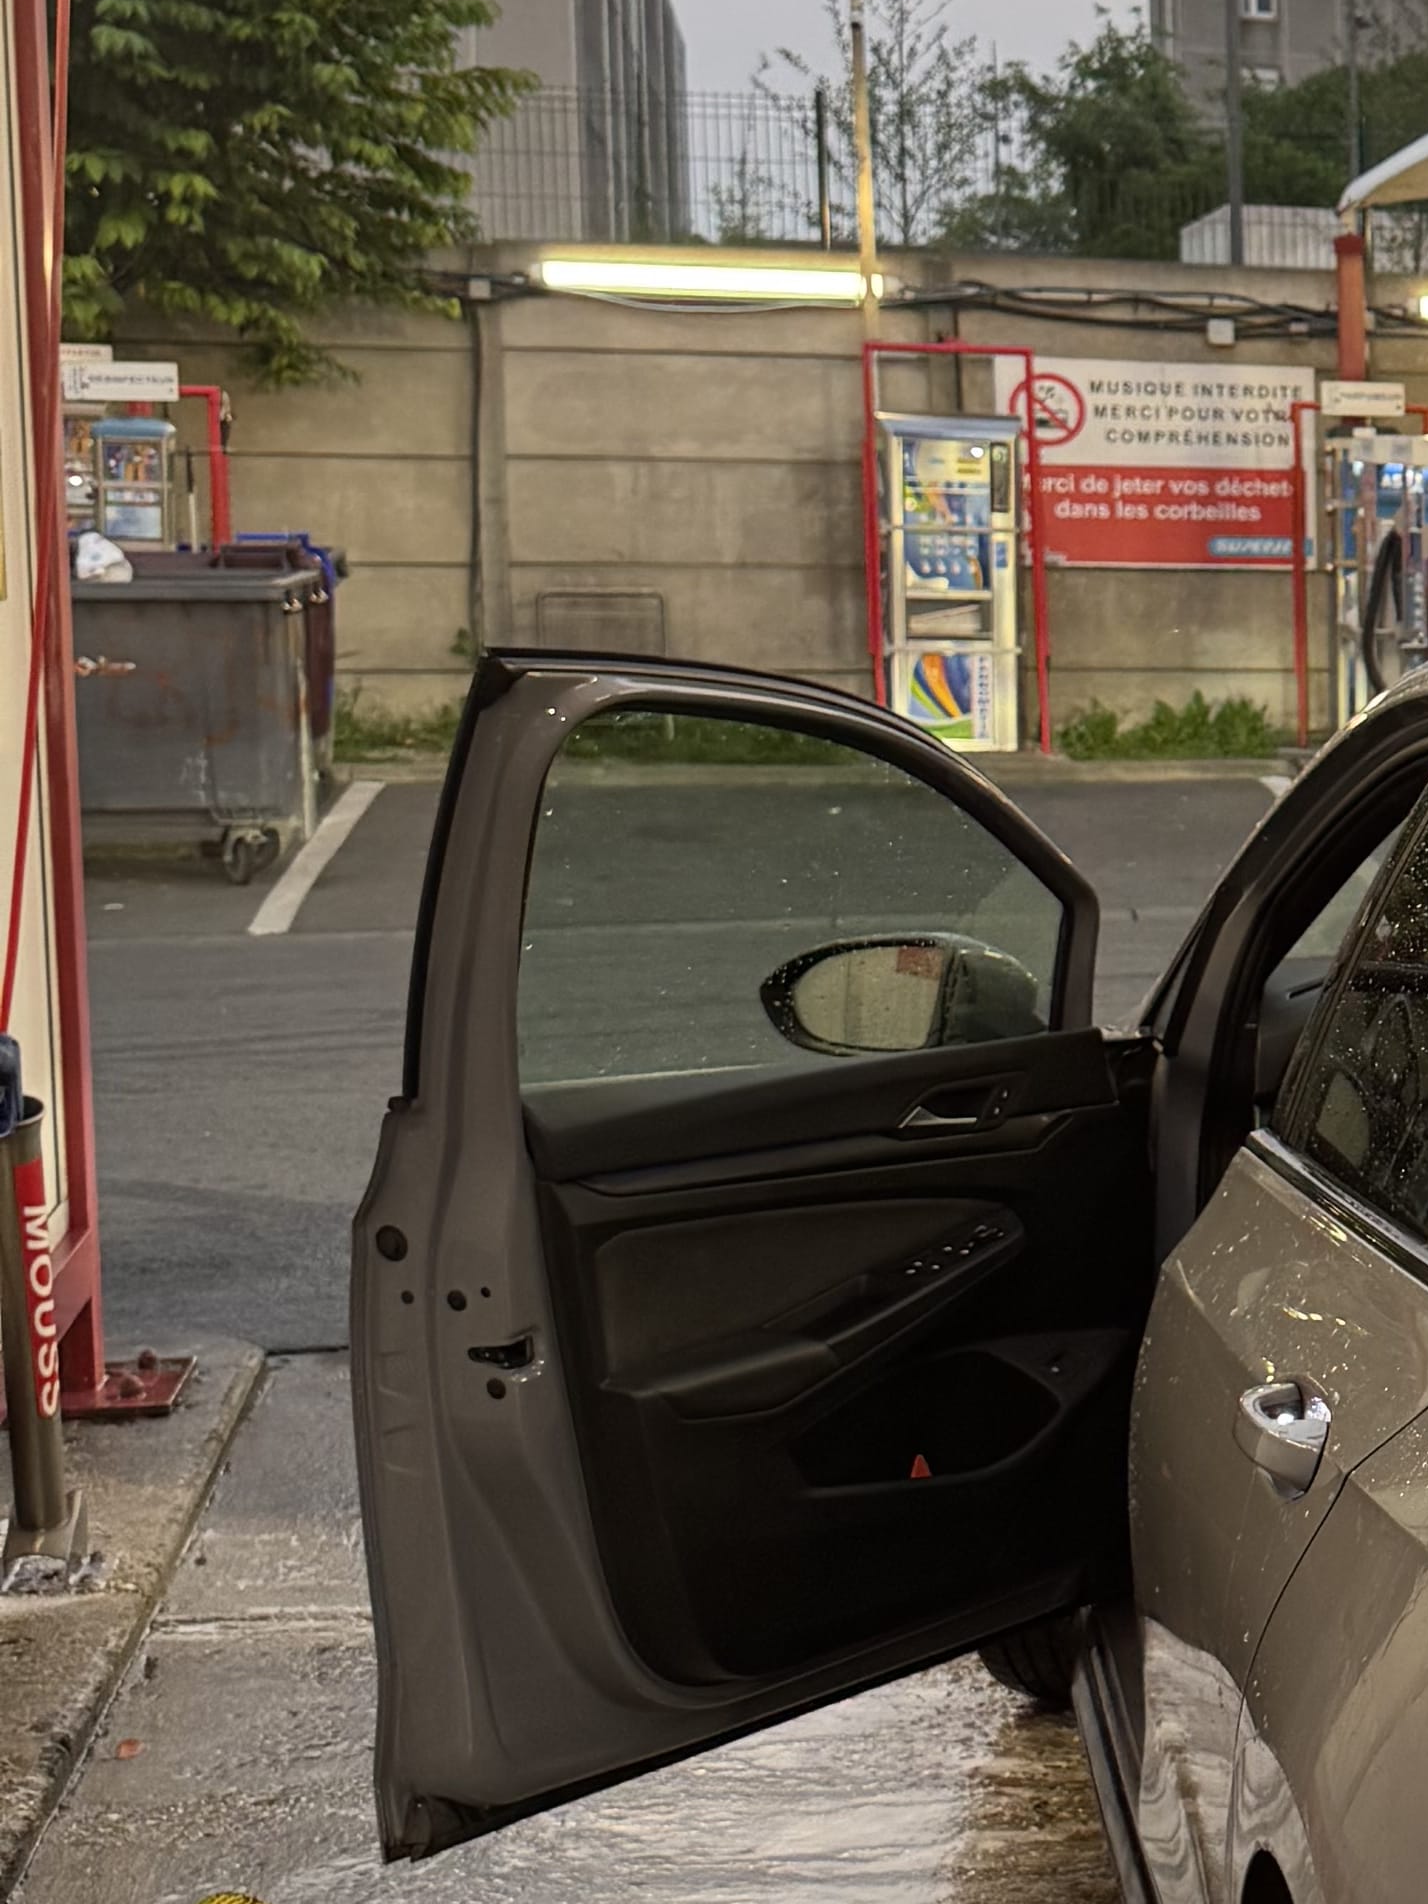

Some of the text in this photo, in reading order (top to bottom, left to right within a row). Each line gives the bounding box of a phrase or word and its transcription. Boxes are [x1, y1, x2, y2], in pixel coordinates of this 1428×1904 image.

[1089, 380, 1184, 397] MUSIQUE
[1094, 404, 1160, 421] MERCI
[1168, 405, 1224, 421] POUR
[1106, 425, 1290, 447] COMPRÉHENSION
[1114, 474, 1165, 499] jeter
[1169, 478, 1209, 495] vos
[1054, 498, 1262, 522] dans les corbeilles
